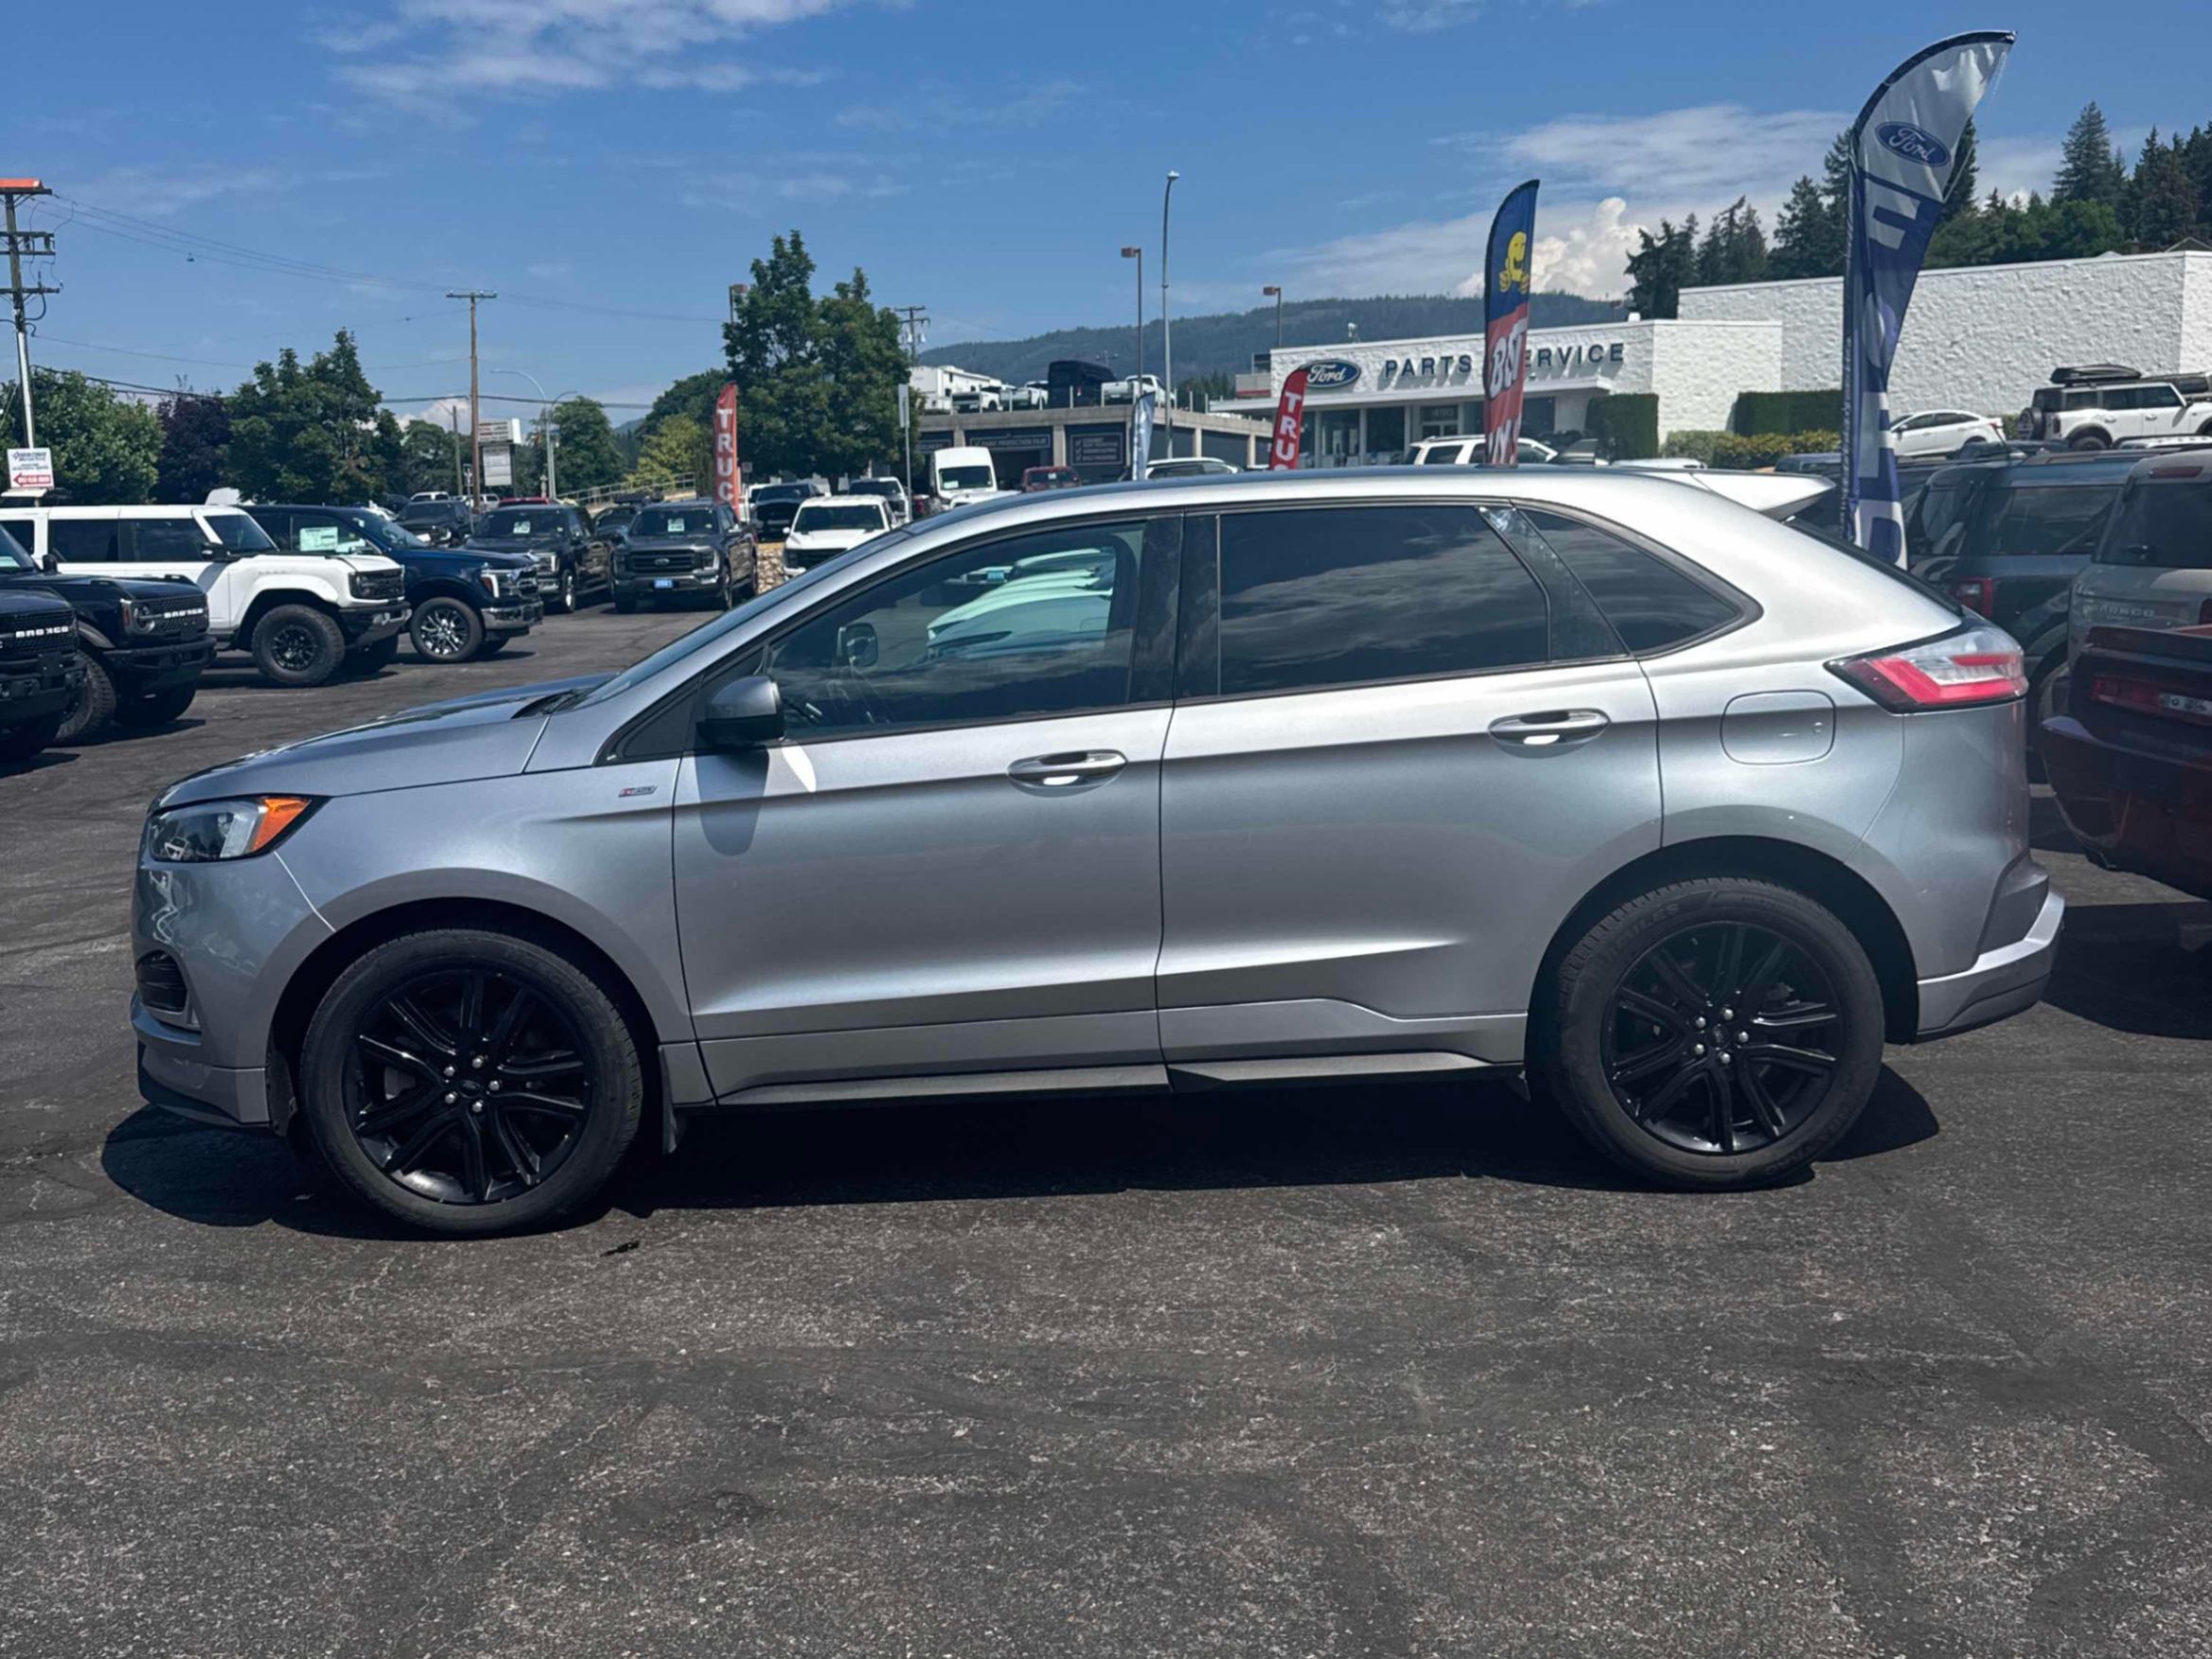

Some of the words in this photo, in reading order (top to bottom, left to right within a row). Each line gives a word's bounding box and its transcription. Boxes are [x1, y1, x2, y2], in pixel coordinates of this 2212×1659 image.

[1888, 127, 1937, 161] Ford
[1307, 363, 1346, 382] Ford
[1385, 354, 1473, 378] PARTS
